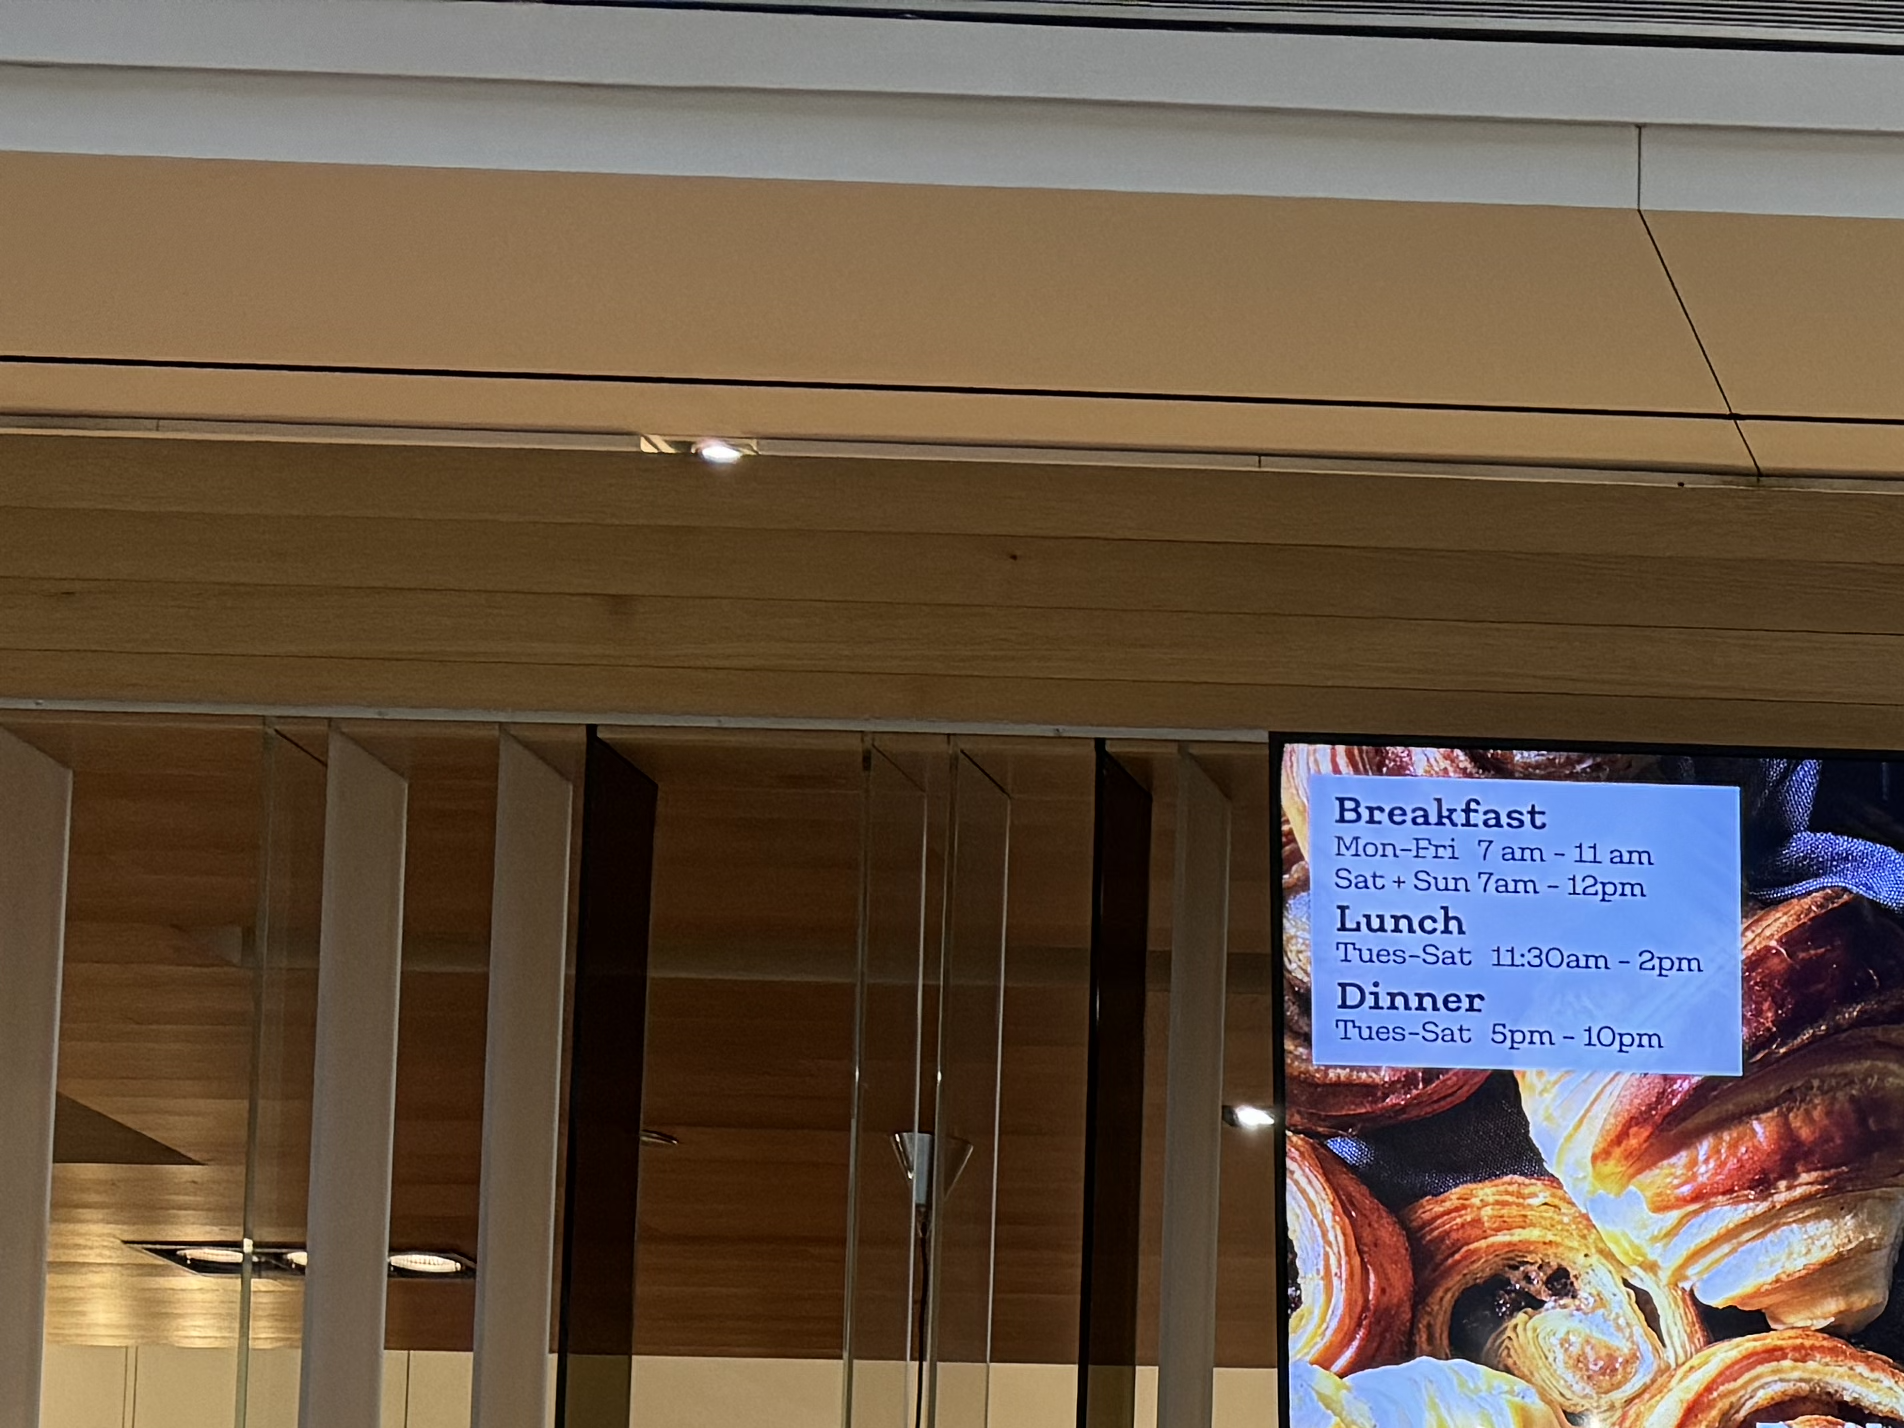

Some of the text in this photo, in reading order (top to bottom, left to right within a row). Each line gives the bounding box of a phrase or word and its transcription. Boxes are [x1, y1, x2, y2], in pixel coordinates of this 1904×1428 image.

[1334, 796, 1547, 830] Breakfast
[1334, 835, 1460, 860] Mon-Fri
[1334, 867, 1386, 891] Sat
[1413, 869, 1471, 893] Sun
[1477, 871, 1540, 895] 7am
[1567, 874, 1647, 903] 12pm
[1336, 904, 1467, 936] Lunch
[1335, 941, 1473, 967] Tues-Sat
[1491, 945, 1611, 970] 11:30am
[1638, 949, 1704, 977] 2pm
[1336, 980, 1486, 1013] Dinner
[1335, 1018, 1472, 1044] Tues-Sat
[1490, 1022, 1556, 1051] 5pm
[1583, 1025, 1664, 1053] 10pm
